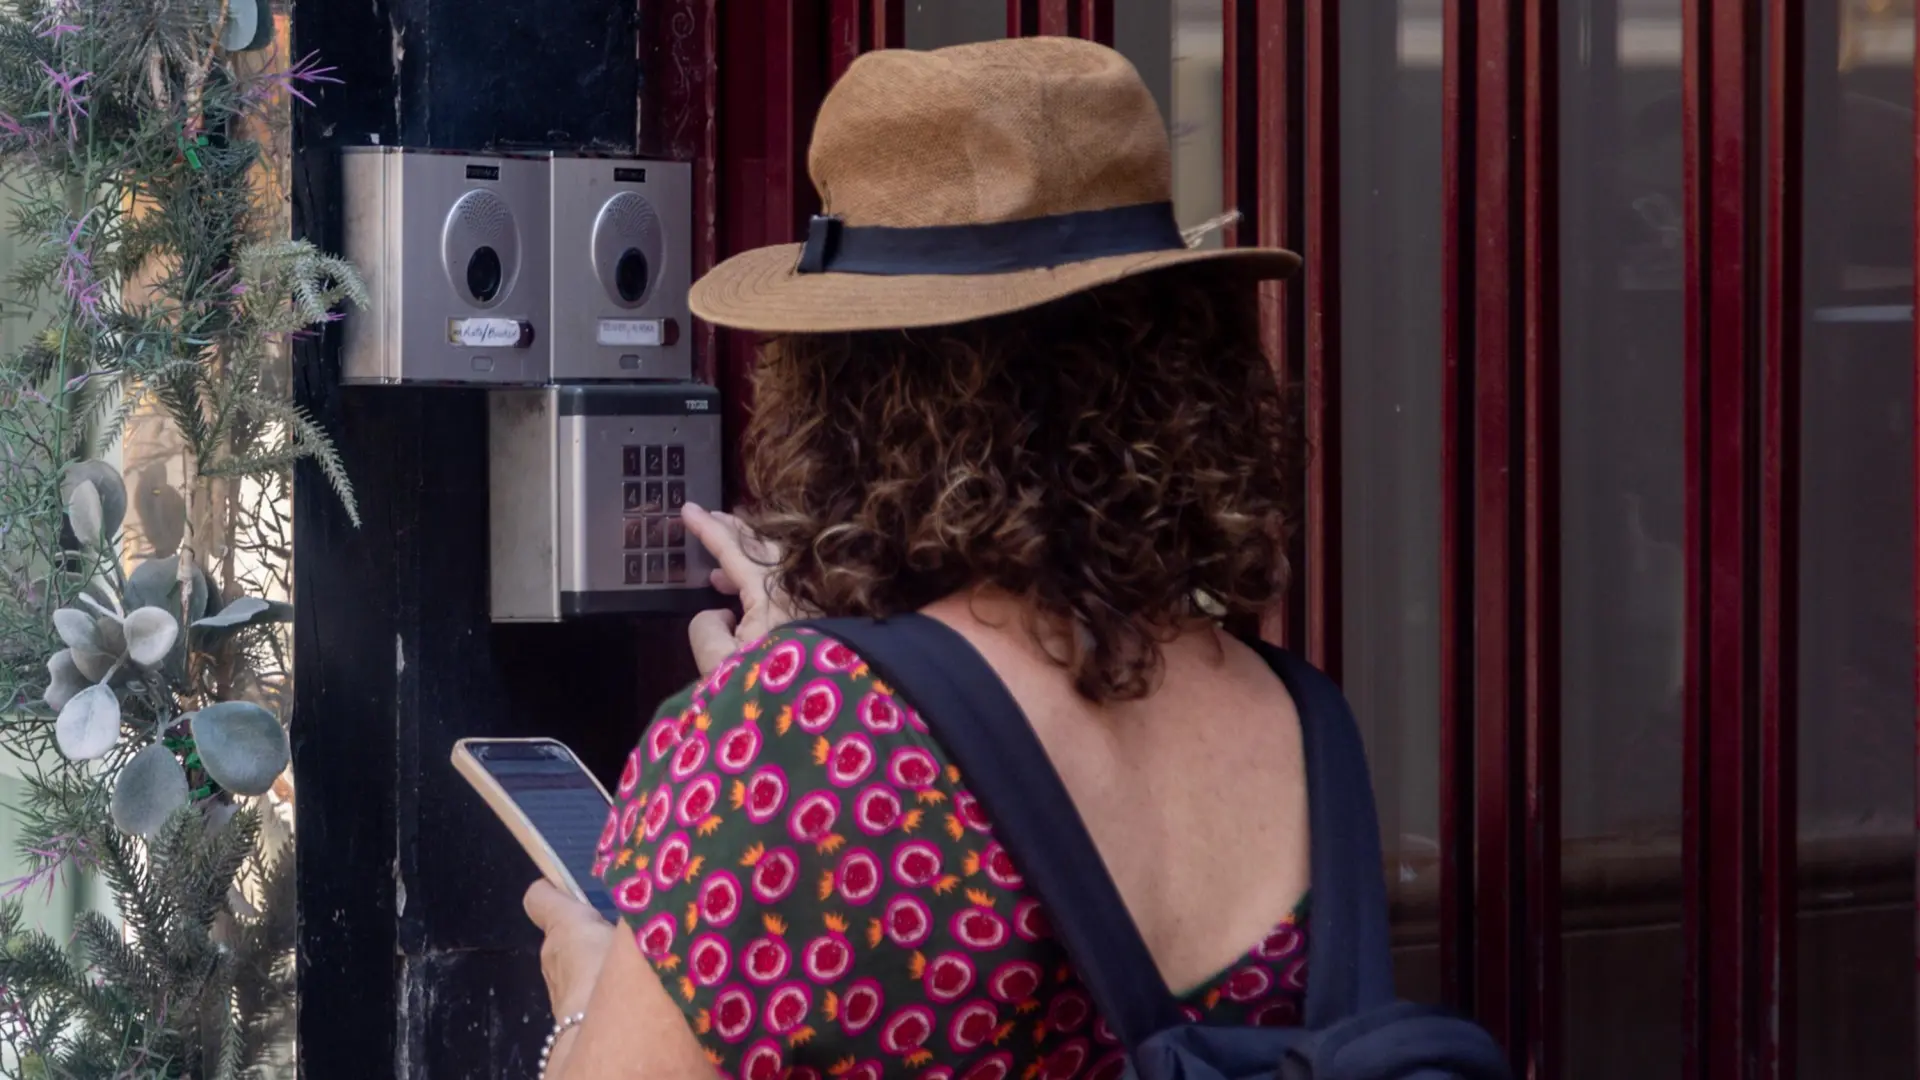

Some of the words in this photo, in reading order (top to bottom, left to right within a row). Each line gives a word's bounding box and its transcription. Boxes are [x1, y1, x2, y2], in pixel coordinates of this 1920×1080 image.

[629, 452, 636, 471] 1
[649, 453, 660, 470] 2
[672, 452, 681, 470] 3
[628, 487, 637, 505] 4
